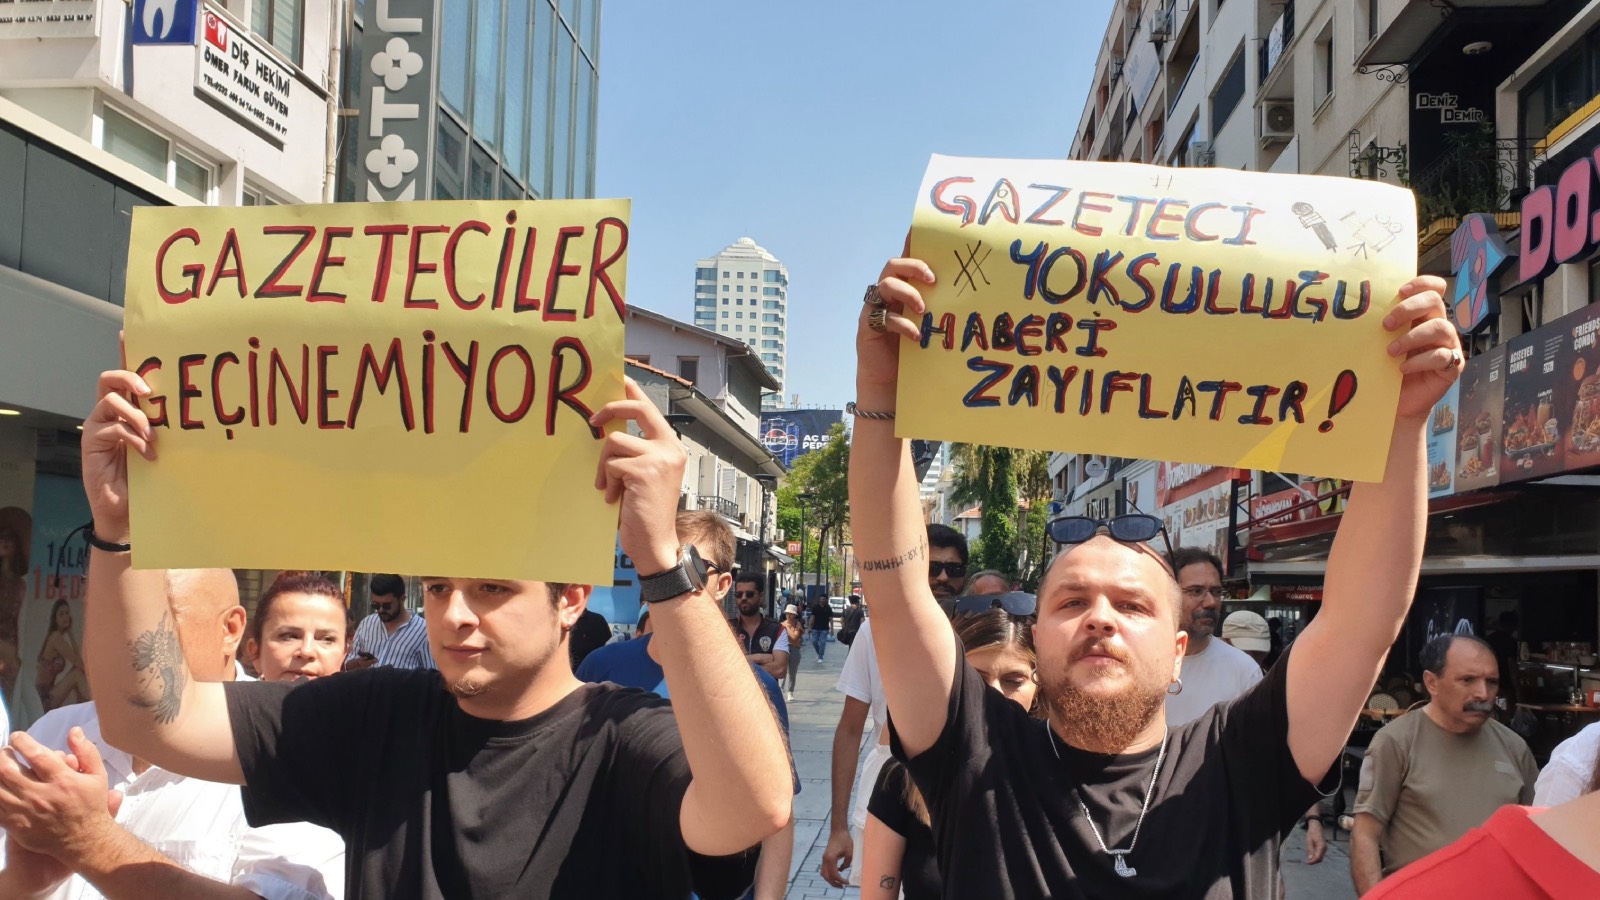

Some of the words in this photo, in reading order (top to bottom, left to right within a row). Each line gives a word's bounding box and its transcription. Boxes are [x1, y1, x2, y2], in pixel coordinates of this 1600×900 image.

[204, 45, 229, 77] ÖMER
[233, 69, 260, 98] FARUK
[263, 90, 288, 118] GÜVEN
[231, 41, 249, 70] DİŞ
[255, 59, 290, 98] HEKİMİ
[930, 176, 1265, 245] GAZETECİ
[1519, 147, 1600, 284] DO
[155, 209, 628, 324] GAZETECİLER
[1010, 239, 1371, 324] YOKSULLUĞU
[919, 311, 1117, 357] HABERİ
[132, 330, 606, 440] GEÇİNEMİYOR
